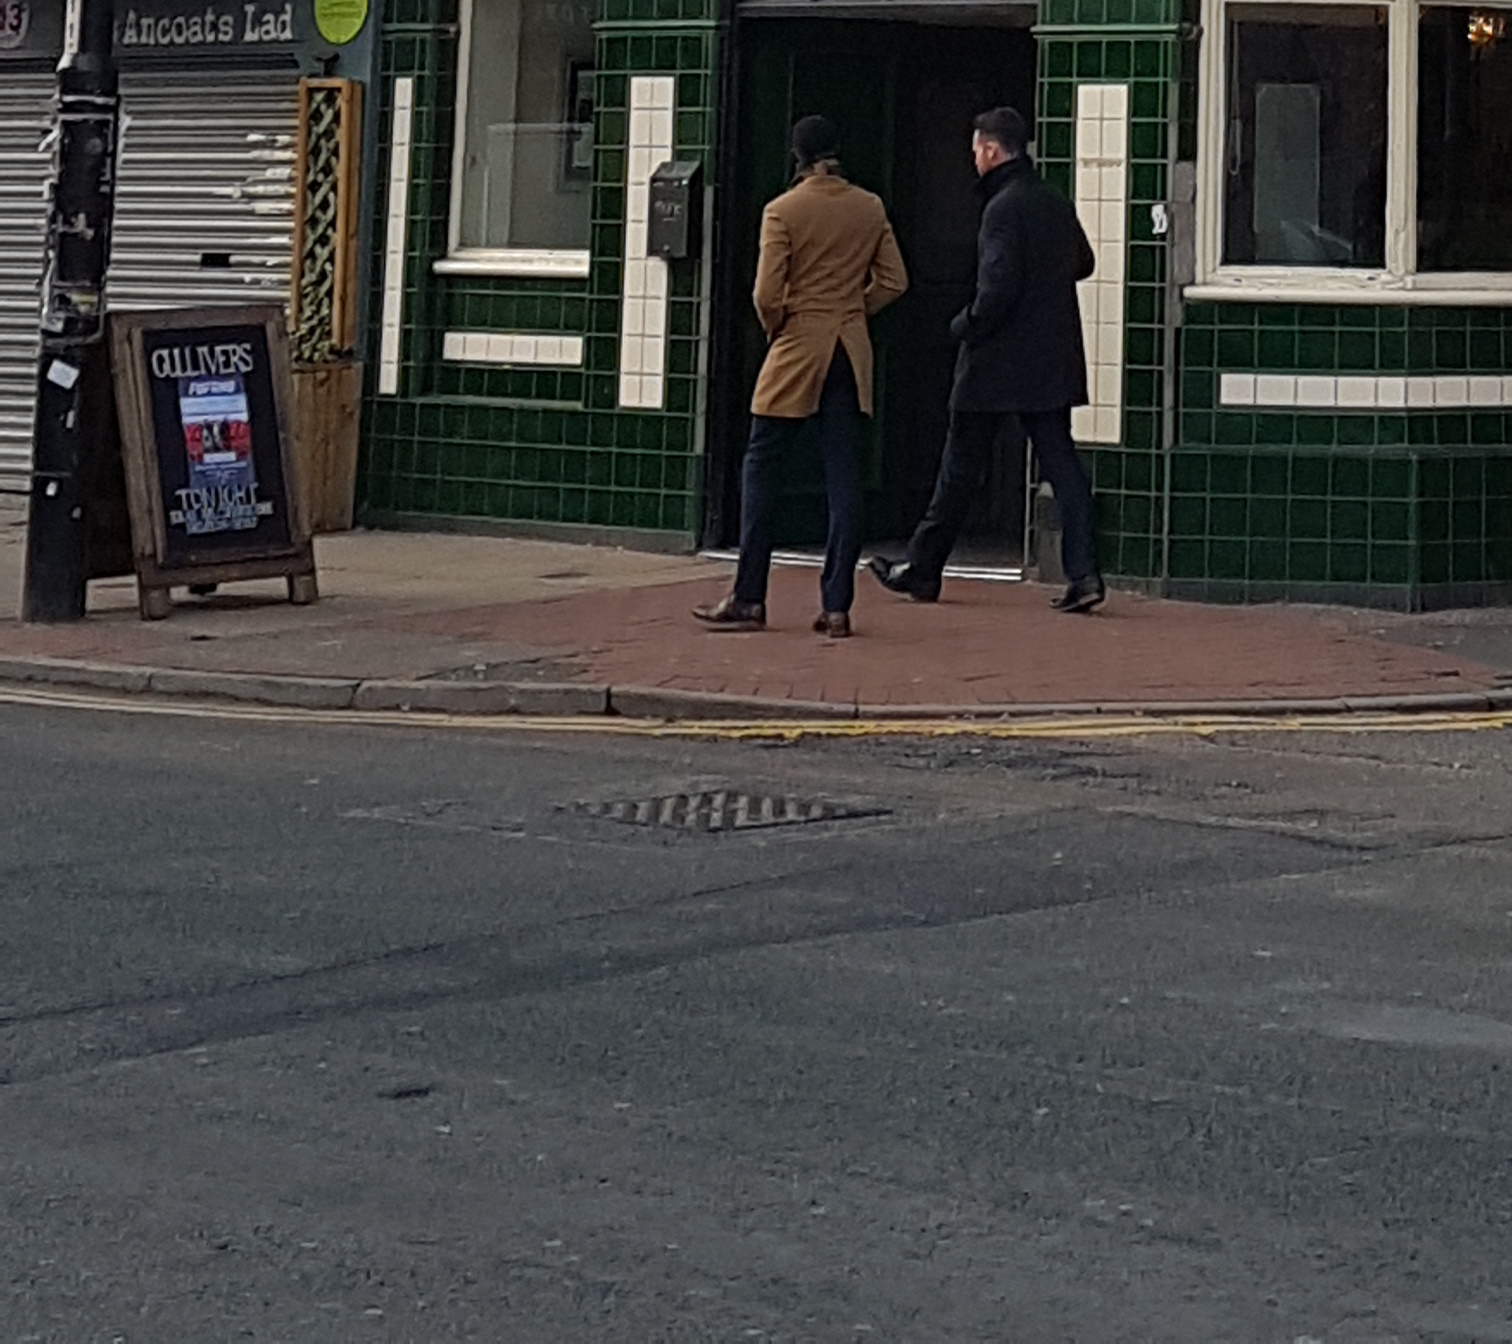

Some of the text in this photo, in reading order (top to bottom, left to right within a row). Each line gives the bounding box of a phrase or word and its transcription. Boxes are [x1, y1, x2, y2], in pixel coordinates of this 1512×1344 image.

[122, 6, 235, 46] Ancoats
[243, 2, 294, 43] Lad
[151, 343, 254, 379] GULLIVERS
